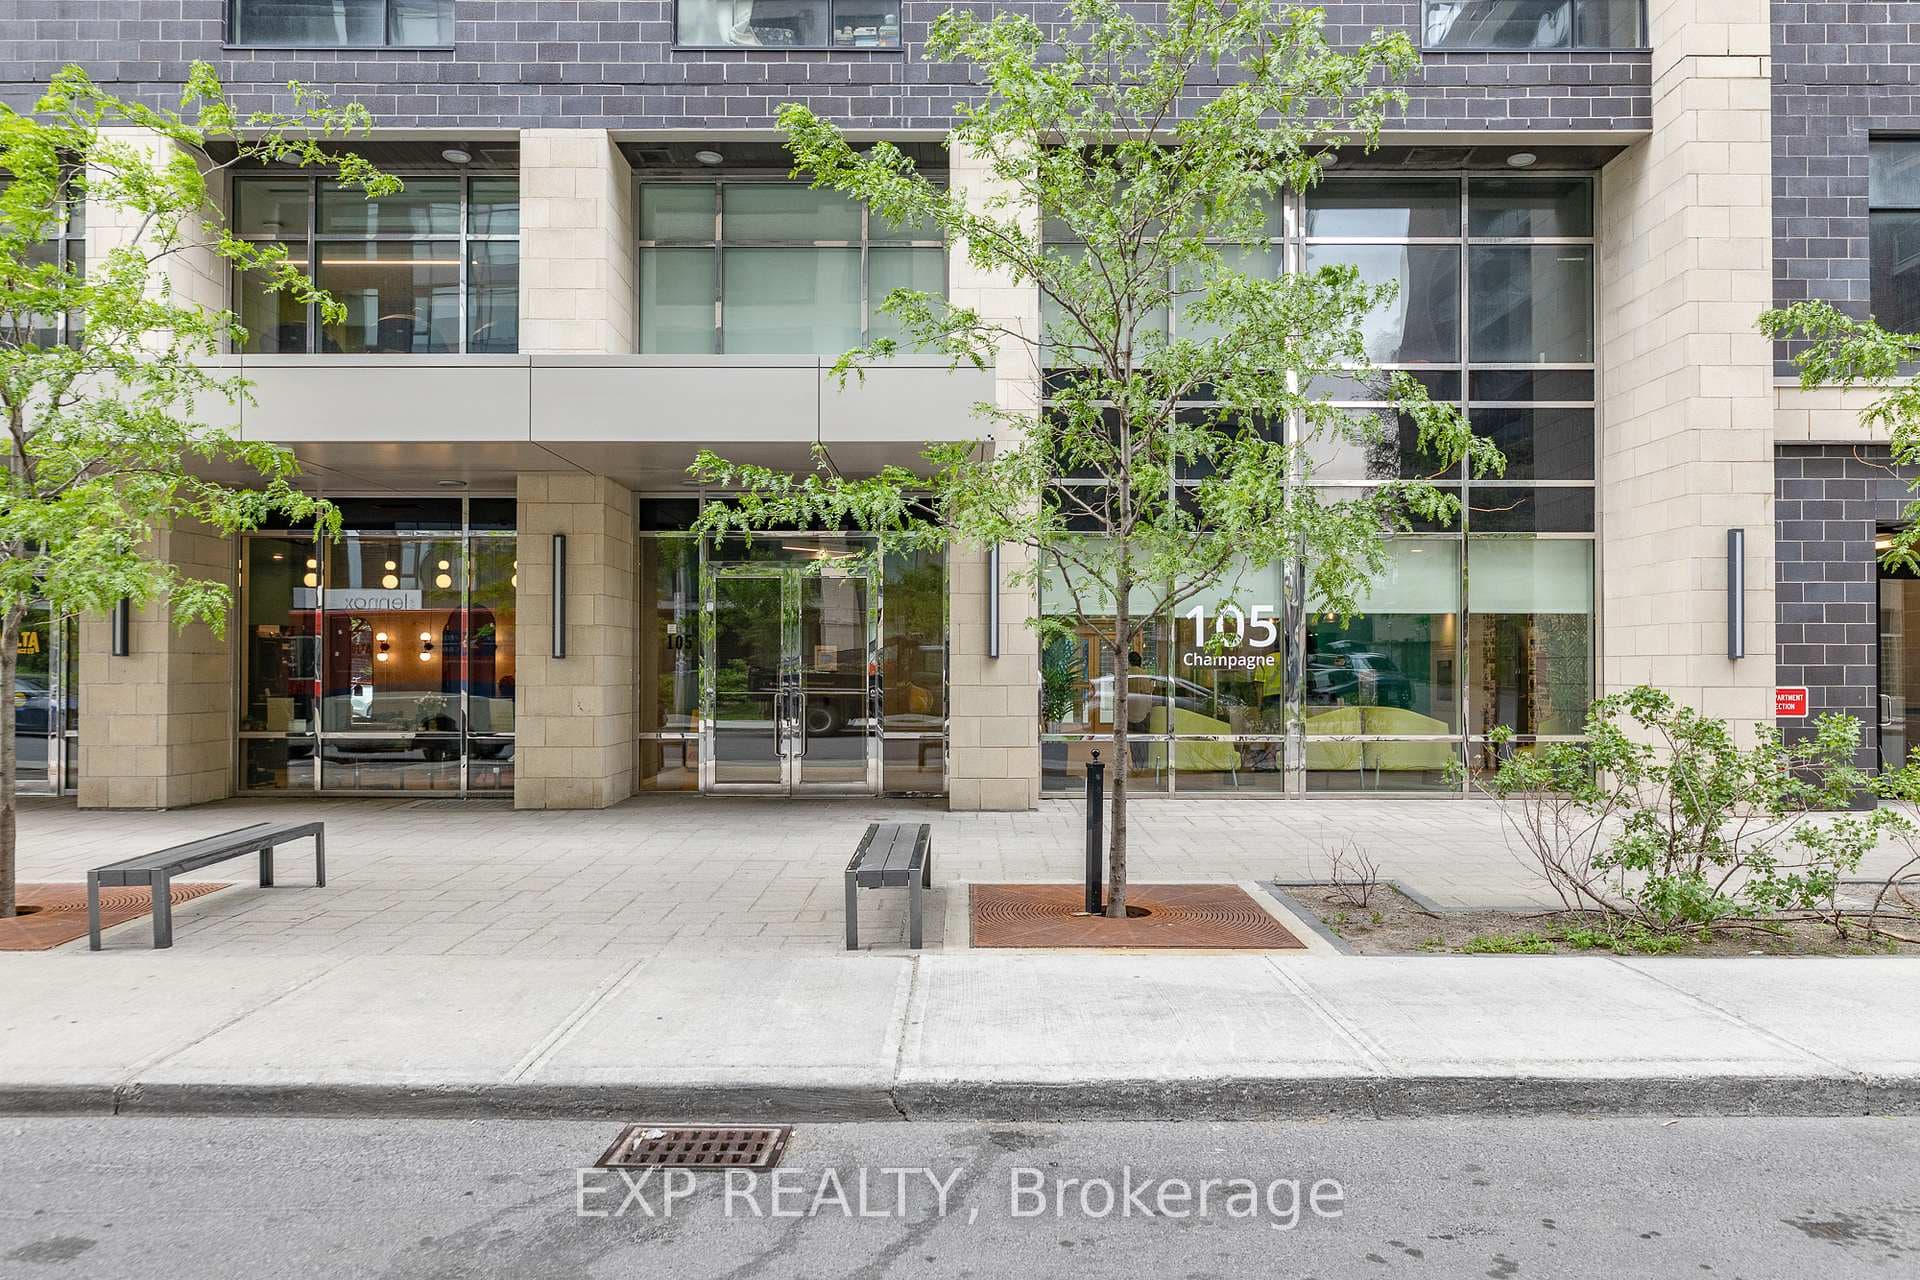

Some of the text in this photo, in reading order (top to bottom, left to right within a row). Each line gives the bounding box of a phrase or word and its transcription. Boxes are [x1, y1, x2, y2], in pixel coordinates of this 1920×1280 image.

[1185, 604, 1278, 648] 105
[666, 634, 693, 650] 105
[1183, 652, 1275, 670] Champagne
